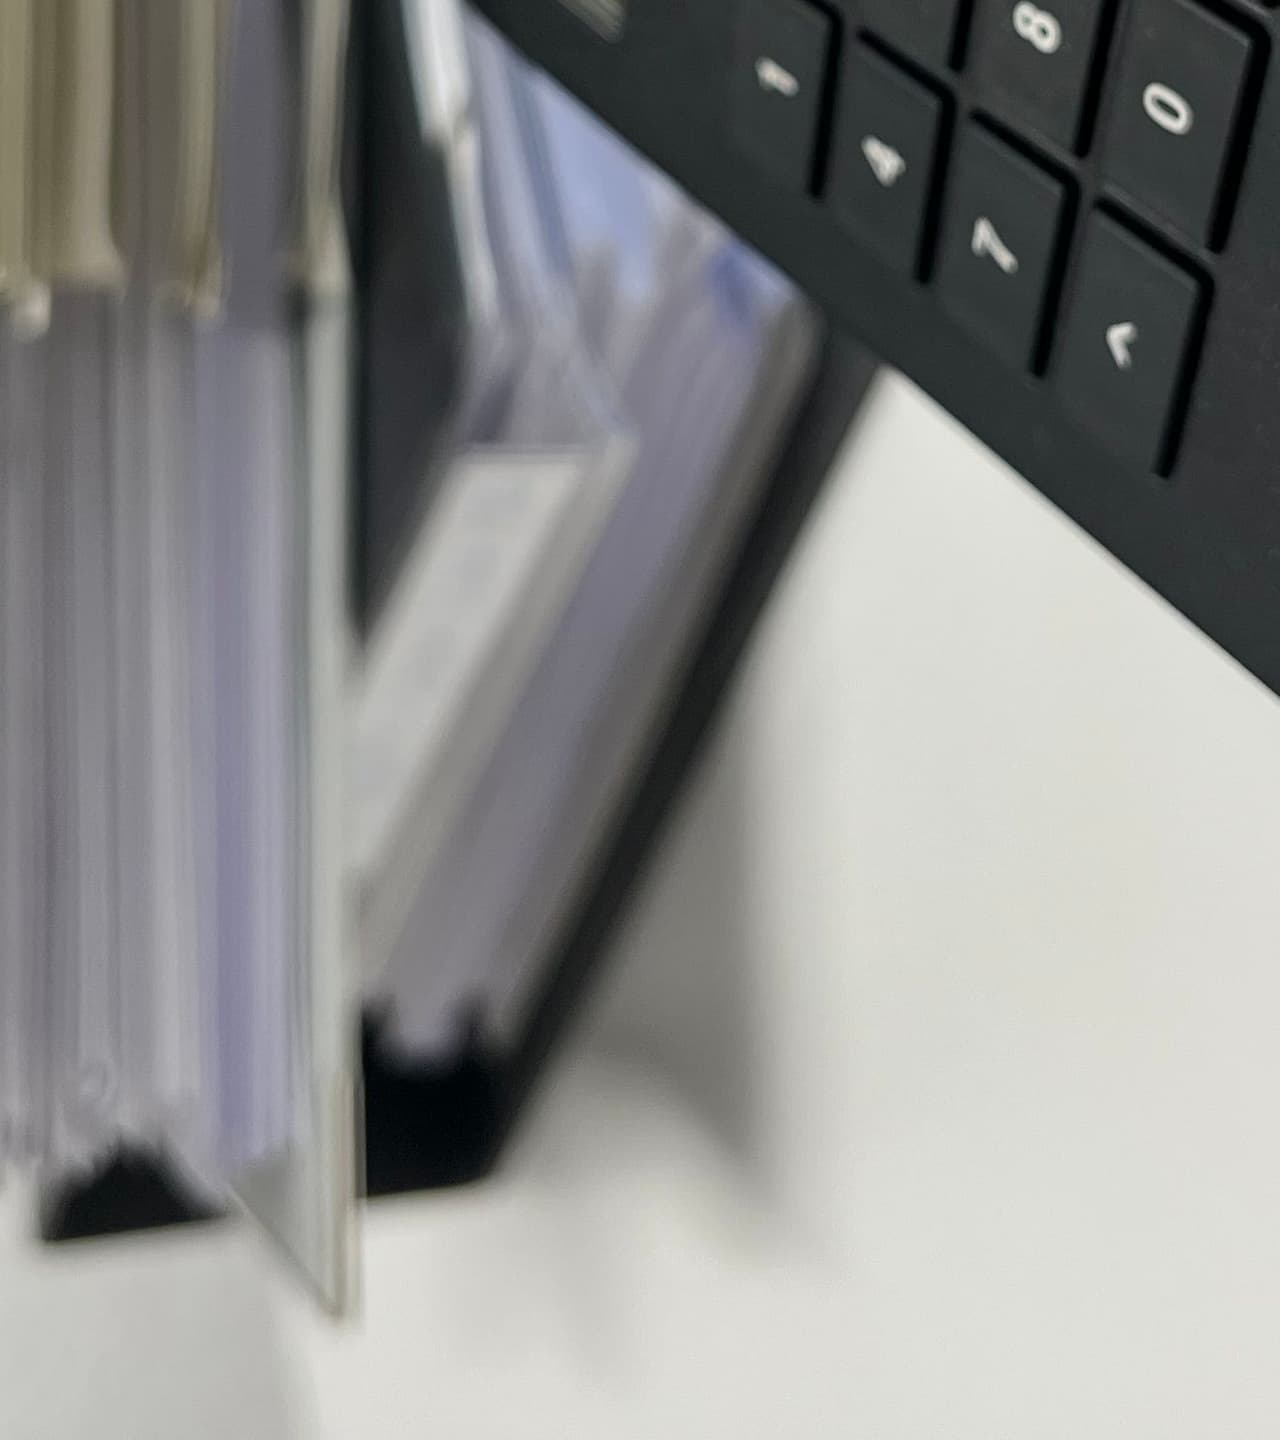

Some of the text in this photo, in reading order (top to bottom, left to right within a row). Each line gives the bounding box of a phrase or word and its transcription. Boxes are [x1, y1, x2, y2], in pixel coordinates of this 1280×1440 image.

[1012, 1, 1061, 54] 8
[754, 57, 798, 98] 1
[1142, 82, 1192, 135] 0
[861, 136, 905, 187] 4
[970, 216, 1018, 274] 7
